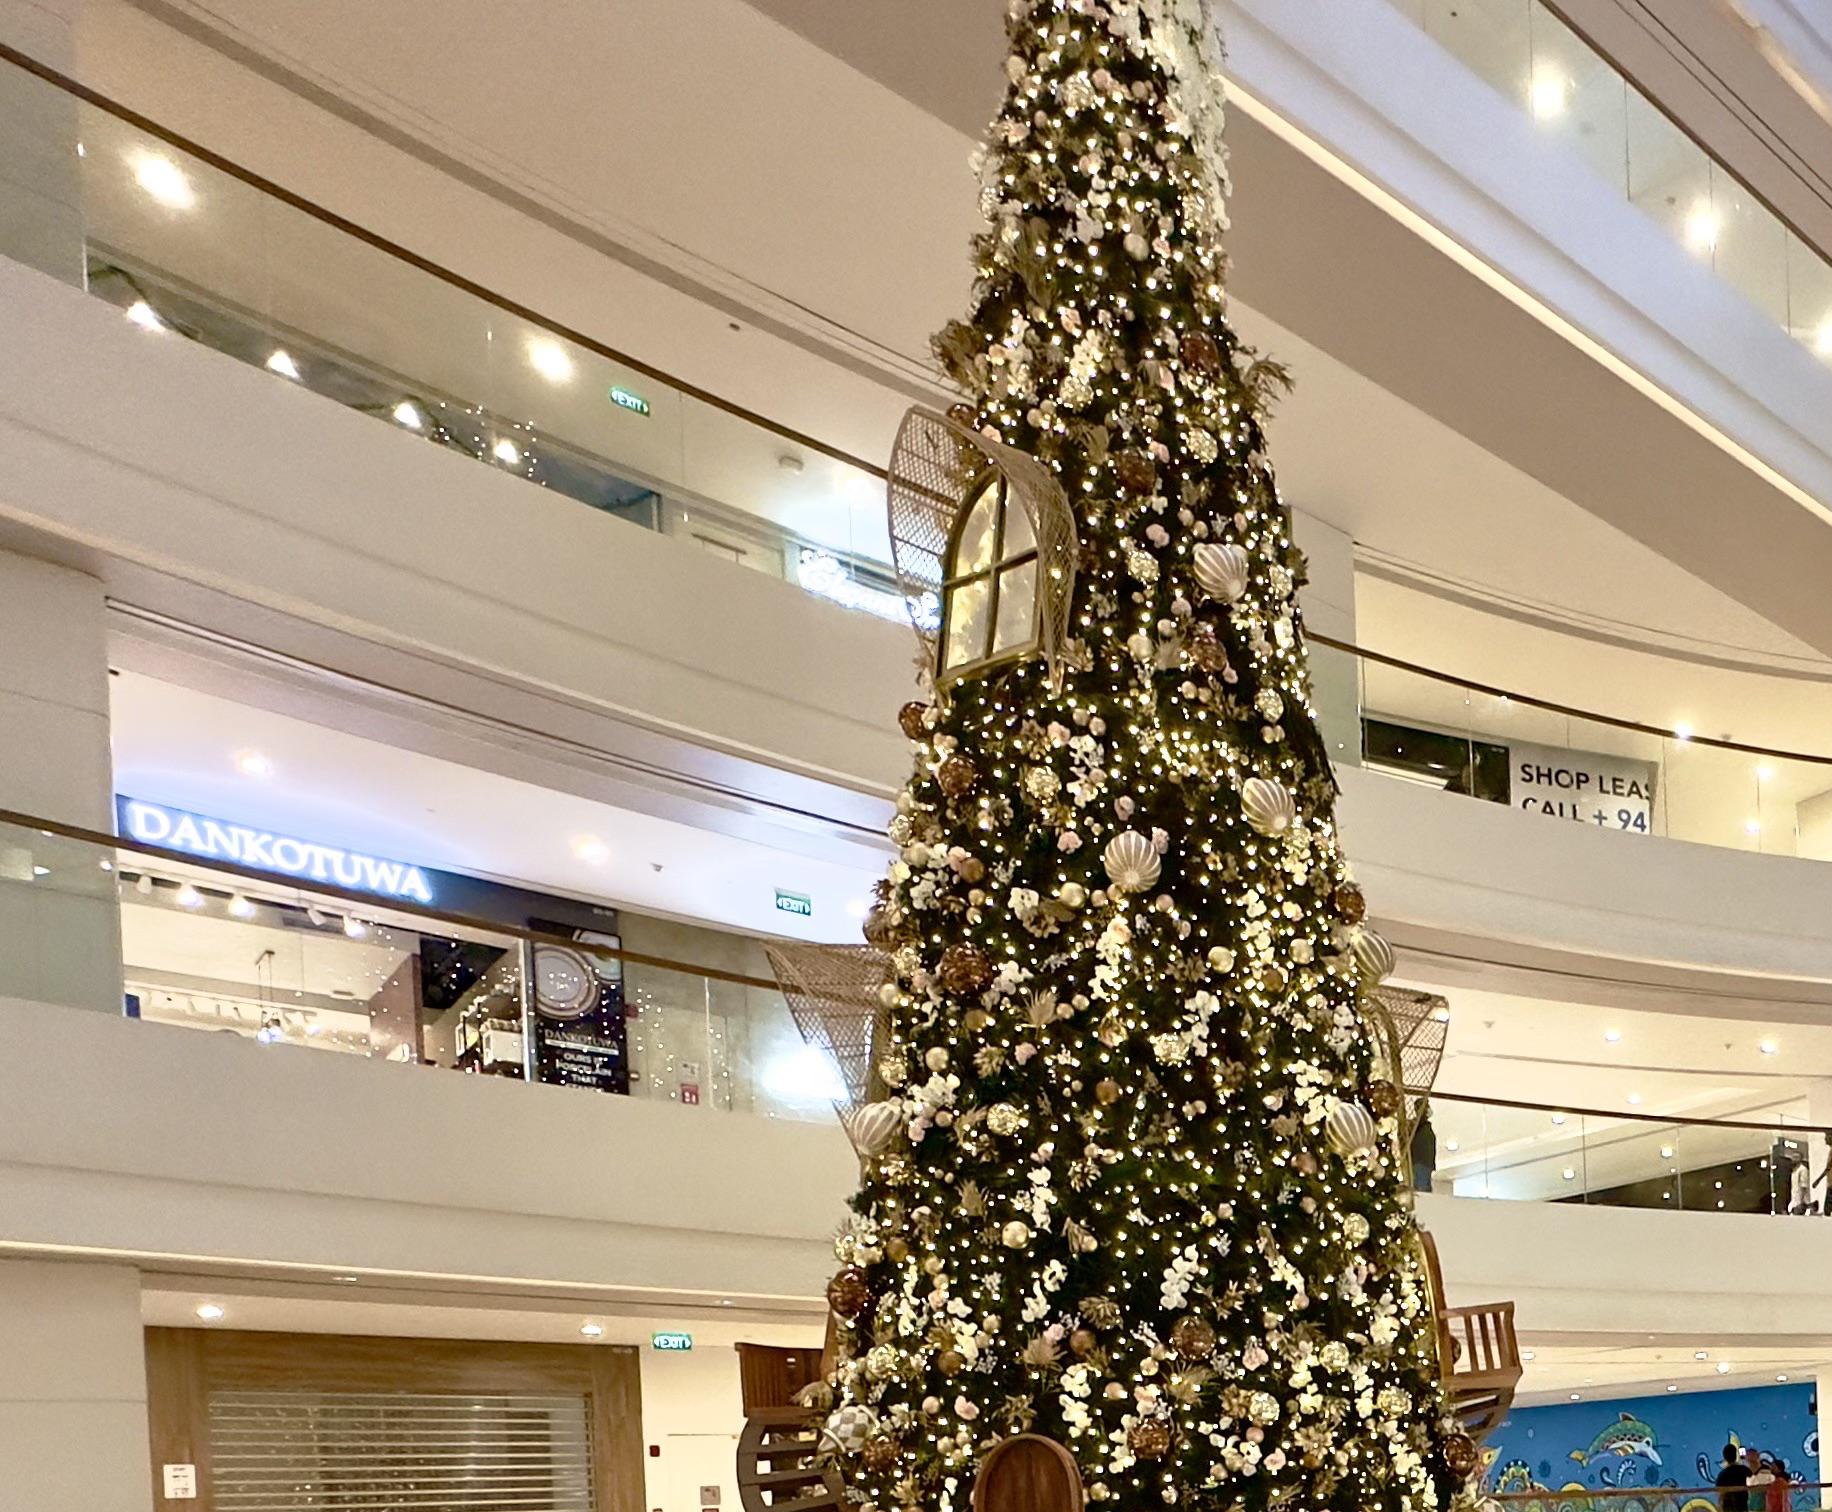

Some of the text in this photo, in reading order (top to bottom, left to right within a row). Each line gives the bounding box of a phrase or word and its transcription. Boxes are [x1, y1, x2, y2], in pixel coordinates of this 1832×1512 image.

[618, 391, 642, 411] EXIT
[1520, 763, 1590, 790] SHOP
[1617, 808, 1647, 832] 94
[128, 801, 433, 903] DANKOTUWA
[783, 897, 804, 914] EXIT
[660, 1335, 683, 1349] EXIT
